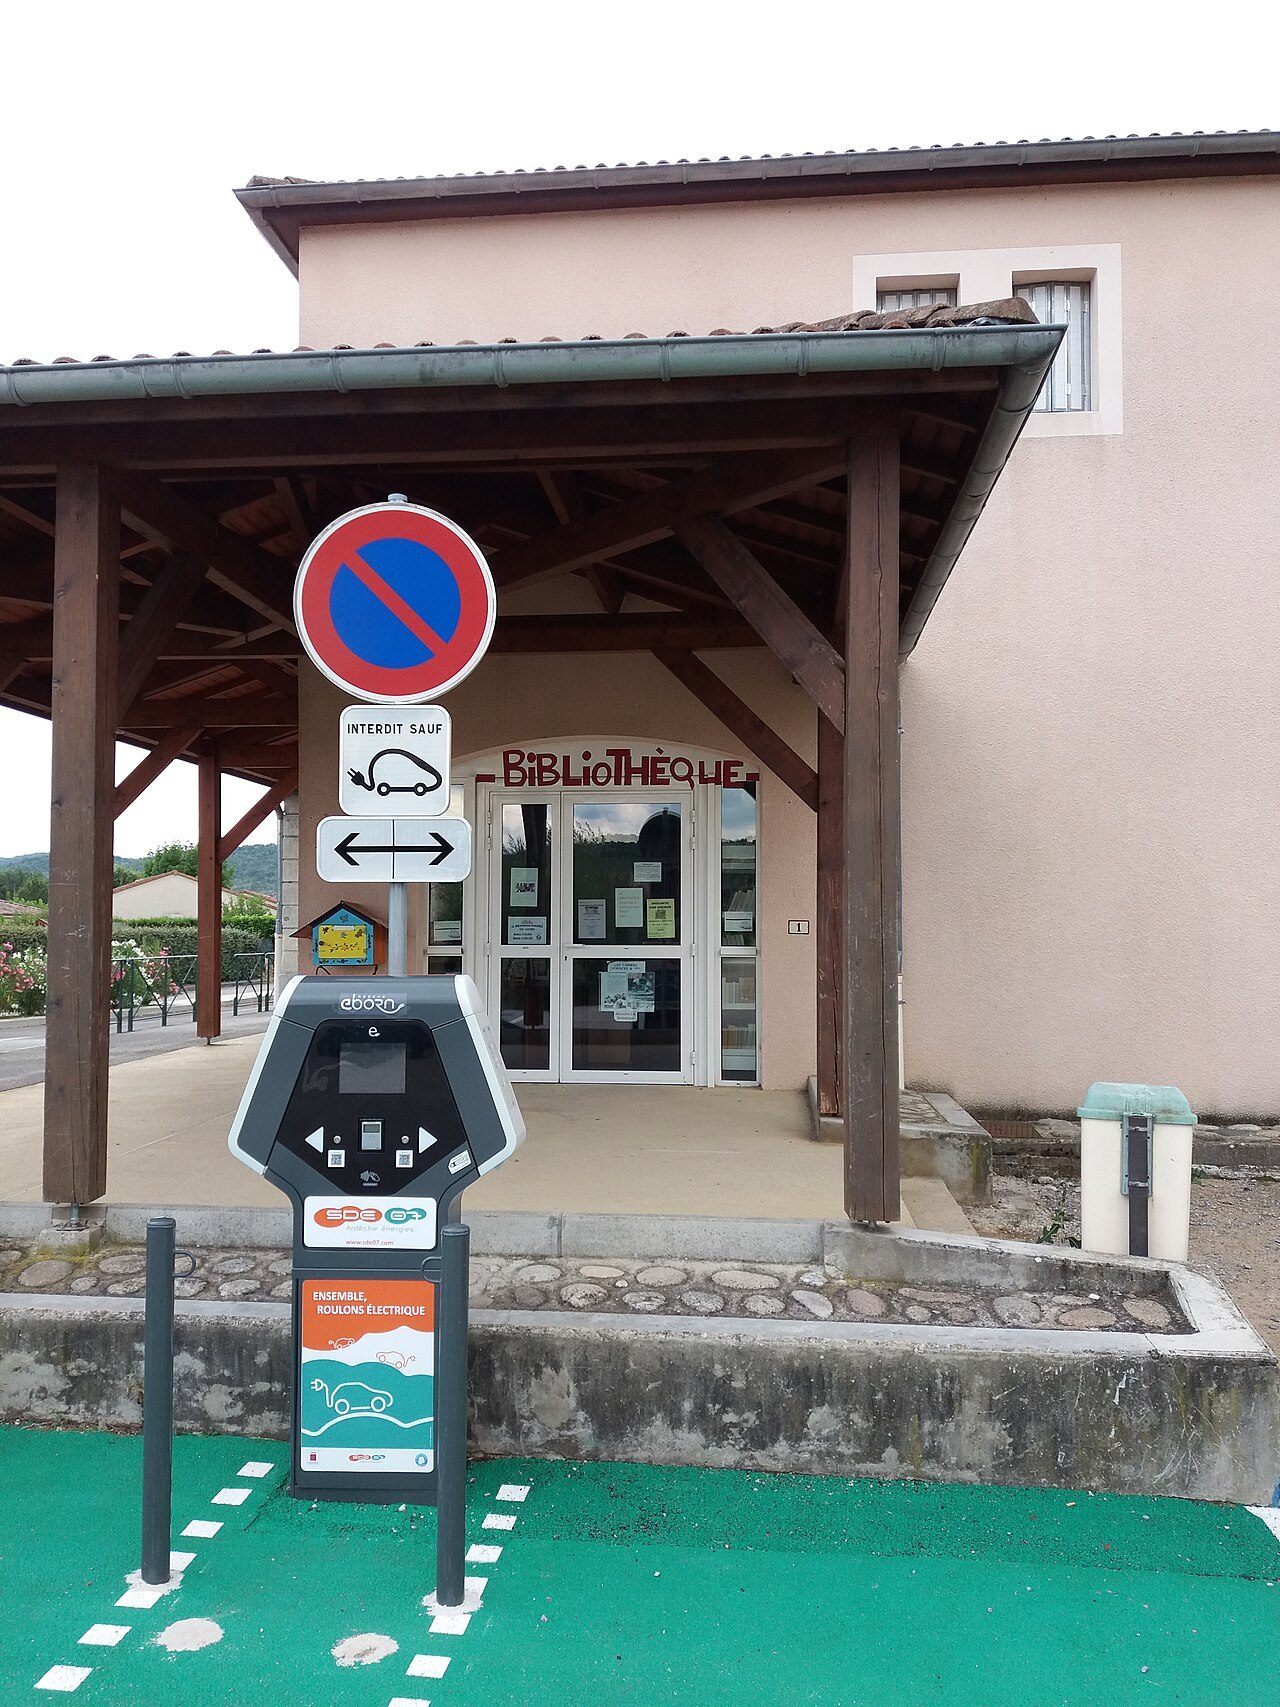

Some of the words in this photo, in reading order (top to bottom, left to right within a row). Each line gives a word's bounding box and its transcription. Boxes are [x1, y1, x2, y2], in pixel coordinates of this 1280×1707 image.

[347, 723, 404, 735] INTERDIT
[409, 723, 443, 735] SAUF
[502, 746, 744, 790] BiBLioTHÈQUE
[796, 922, 801, 932] 1
[341, 994, 405, 1014] eborn
[326, 1209, 376, 1221] SDE
[390, 1210, 422, 1221] 07
[313, 1292, 367, 1303] ENSEMBLE,
[317, 1305, 364, 1316] ROULONS
[366, 1304, 425, 1316] ÉLECTRIQUE
